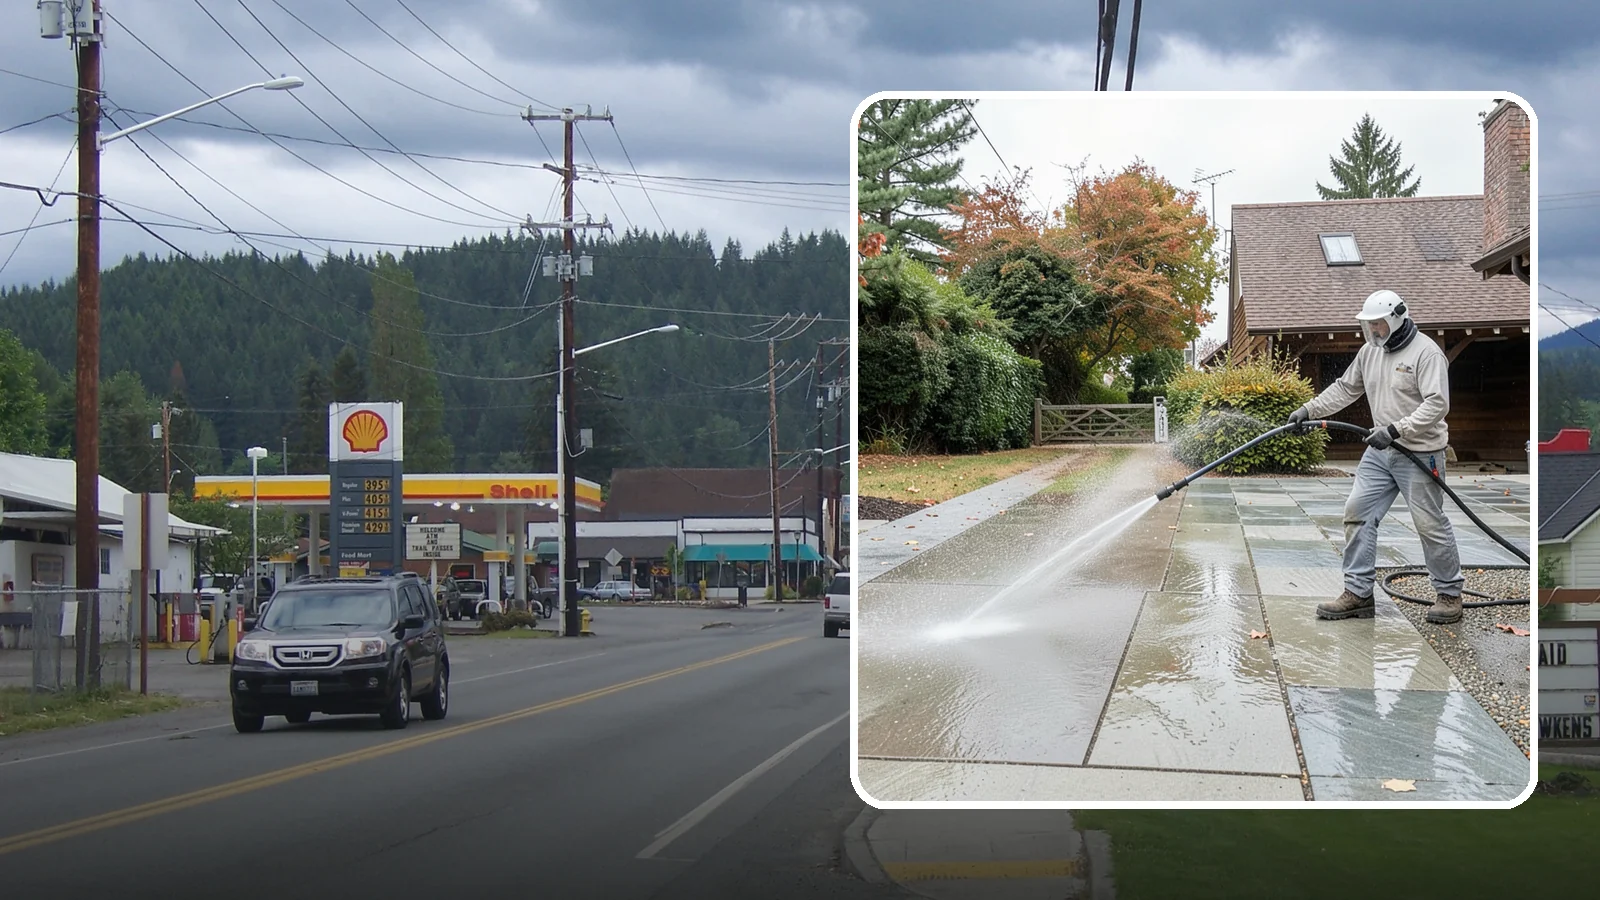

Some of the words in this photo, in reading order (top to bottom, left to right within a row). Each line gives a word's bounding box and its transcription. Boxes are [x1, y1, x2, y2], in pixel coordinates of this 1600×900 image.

[366, 480, 383, 490] 395
[490, 484, 547, 499] Shell
[366, 494, 383, 504] 405
[366, 508, 383, 518] 415
[366, 522, 383, 532] 429
